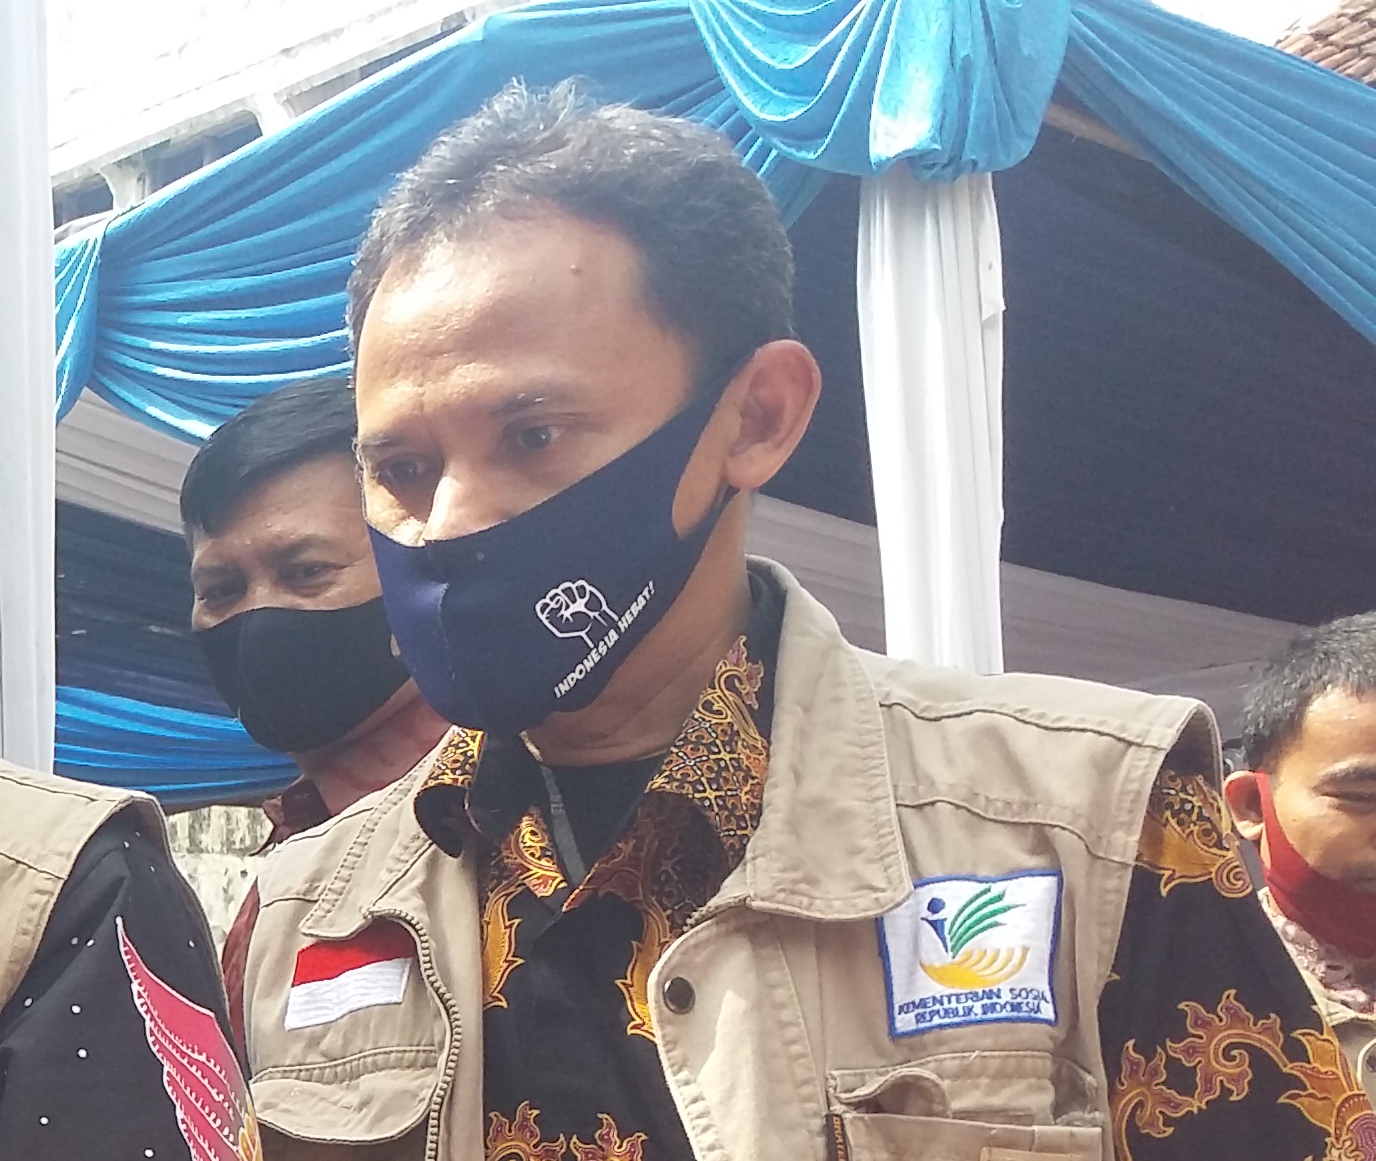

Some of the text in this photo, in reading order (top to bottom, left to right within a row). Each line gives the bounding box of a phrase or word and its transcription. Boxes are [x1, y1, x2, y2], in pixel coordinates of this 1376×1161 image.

[553, 579, 656, 699] INDONESIA HEBAT!
[898, 988, 1002, 1016] KEMENTERIAN
[914, 1000, 1043, 1024] REPUBLIK INDONESIA
